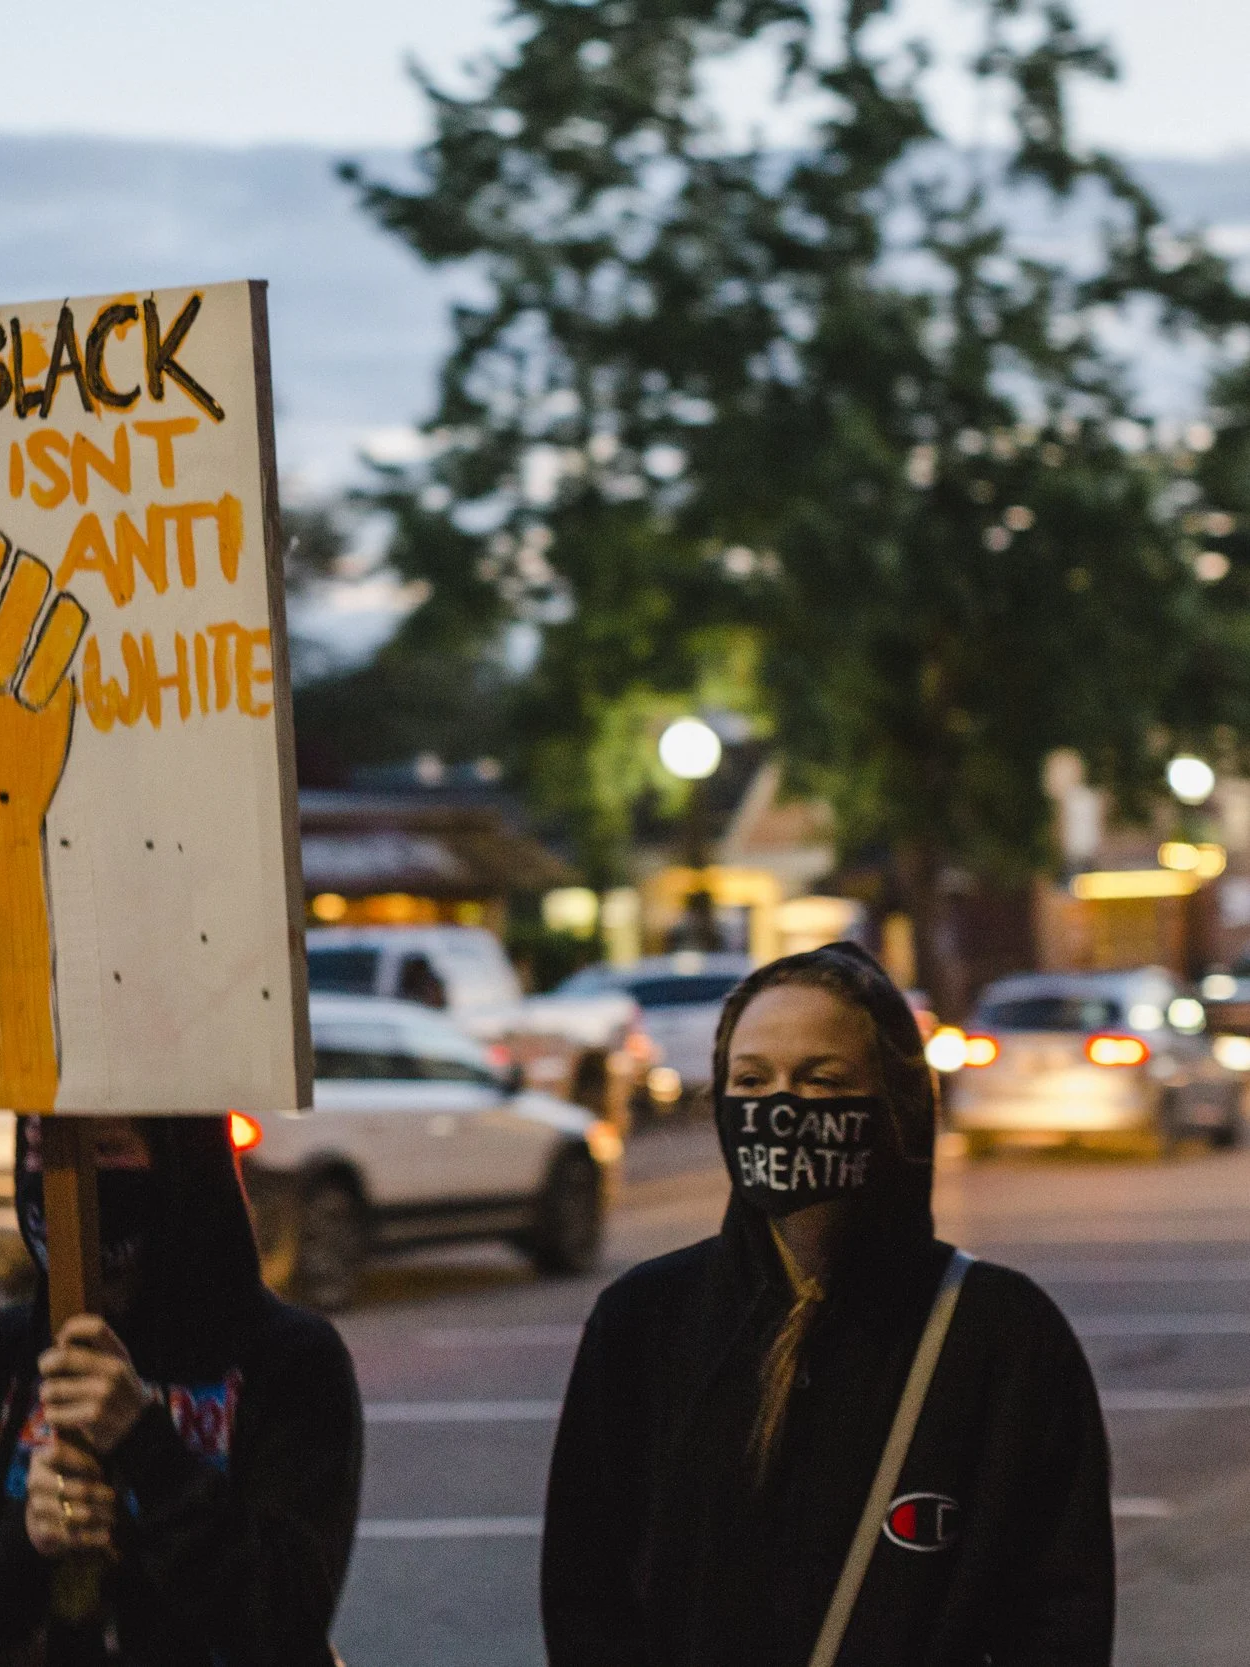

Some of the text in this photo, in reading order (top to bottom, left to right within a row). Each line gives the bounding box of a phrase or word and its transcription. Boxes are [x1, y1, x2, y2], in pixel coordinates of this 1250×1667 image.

[8, 417, 200, 509] ISNT
[55, 493, 244, 608] ANTI
[83, 621, 274, 734] WHITE
[740, 1101, 871, 1144] I CANT
